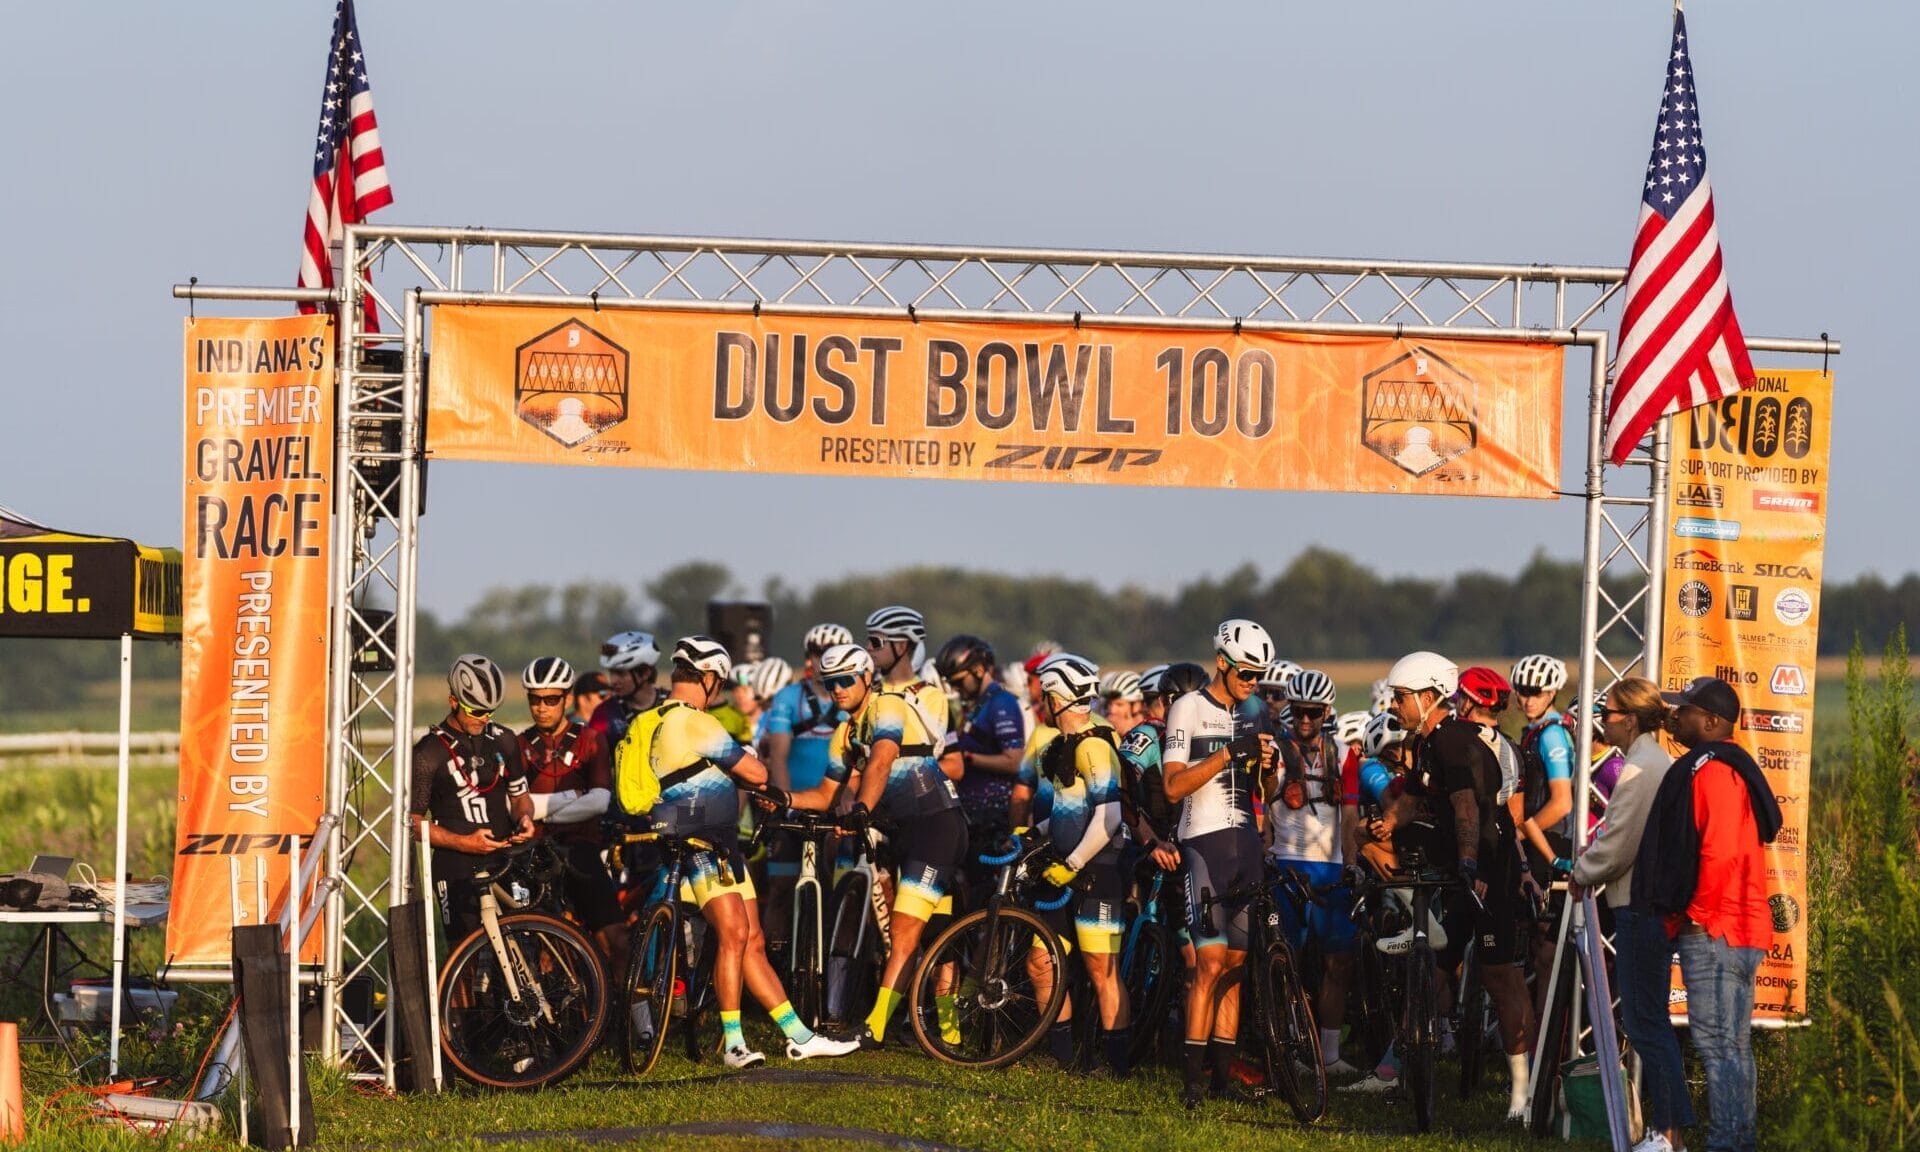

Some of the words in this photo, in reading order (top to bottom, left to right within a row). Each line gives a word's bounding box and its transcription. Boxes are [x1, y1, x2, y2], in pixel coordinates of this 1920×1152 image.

[197, 337, 324, 373] INDIANA'S
[197, 385, 322, 426] PREMIER
[712, 330, 903, 427] DUST
[925, 338, 1136, 435] BOWL
[1156, 347, 1277, 439] 100
[197, 436, 322, 482] GRAVEL
[821, 436, 940, 465] PRESENTED
[949, 441, 976, 466] BY
[984, 444, 1163, 472] ZIPP
[1680, 459, 1733, 479] SUPPORT
[1736, 465, 1797, 484] PROVIDED
[1801, 469, 1819, 485] BY
[197, 493, 321, 559] RACE
[0, 553, 90, 614] GE.
[1752, 563, 1814, 580] SILCA
[230, 571, 273, 763] PRESENTED
[229, 775, 269, 818] BY
